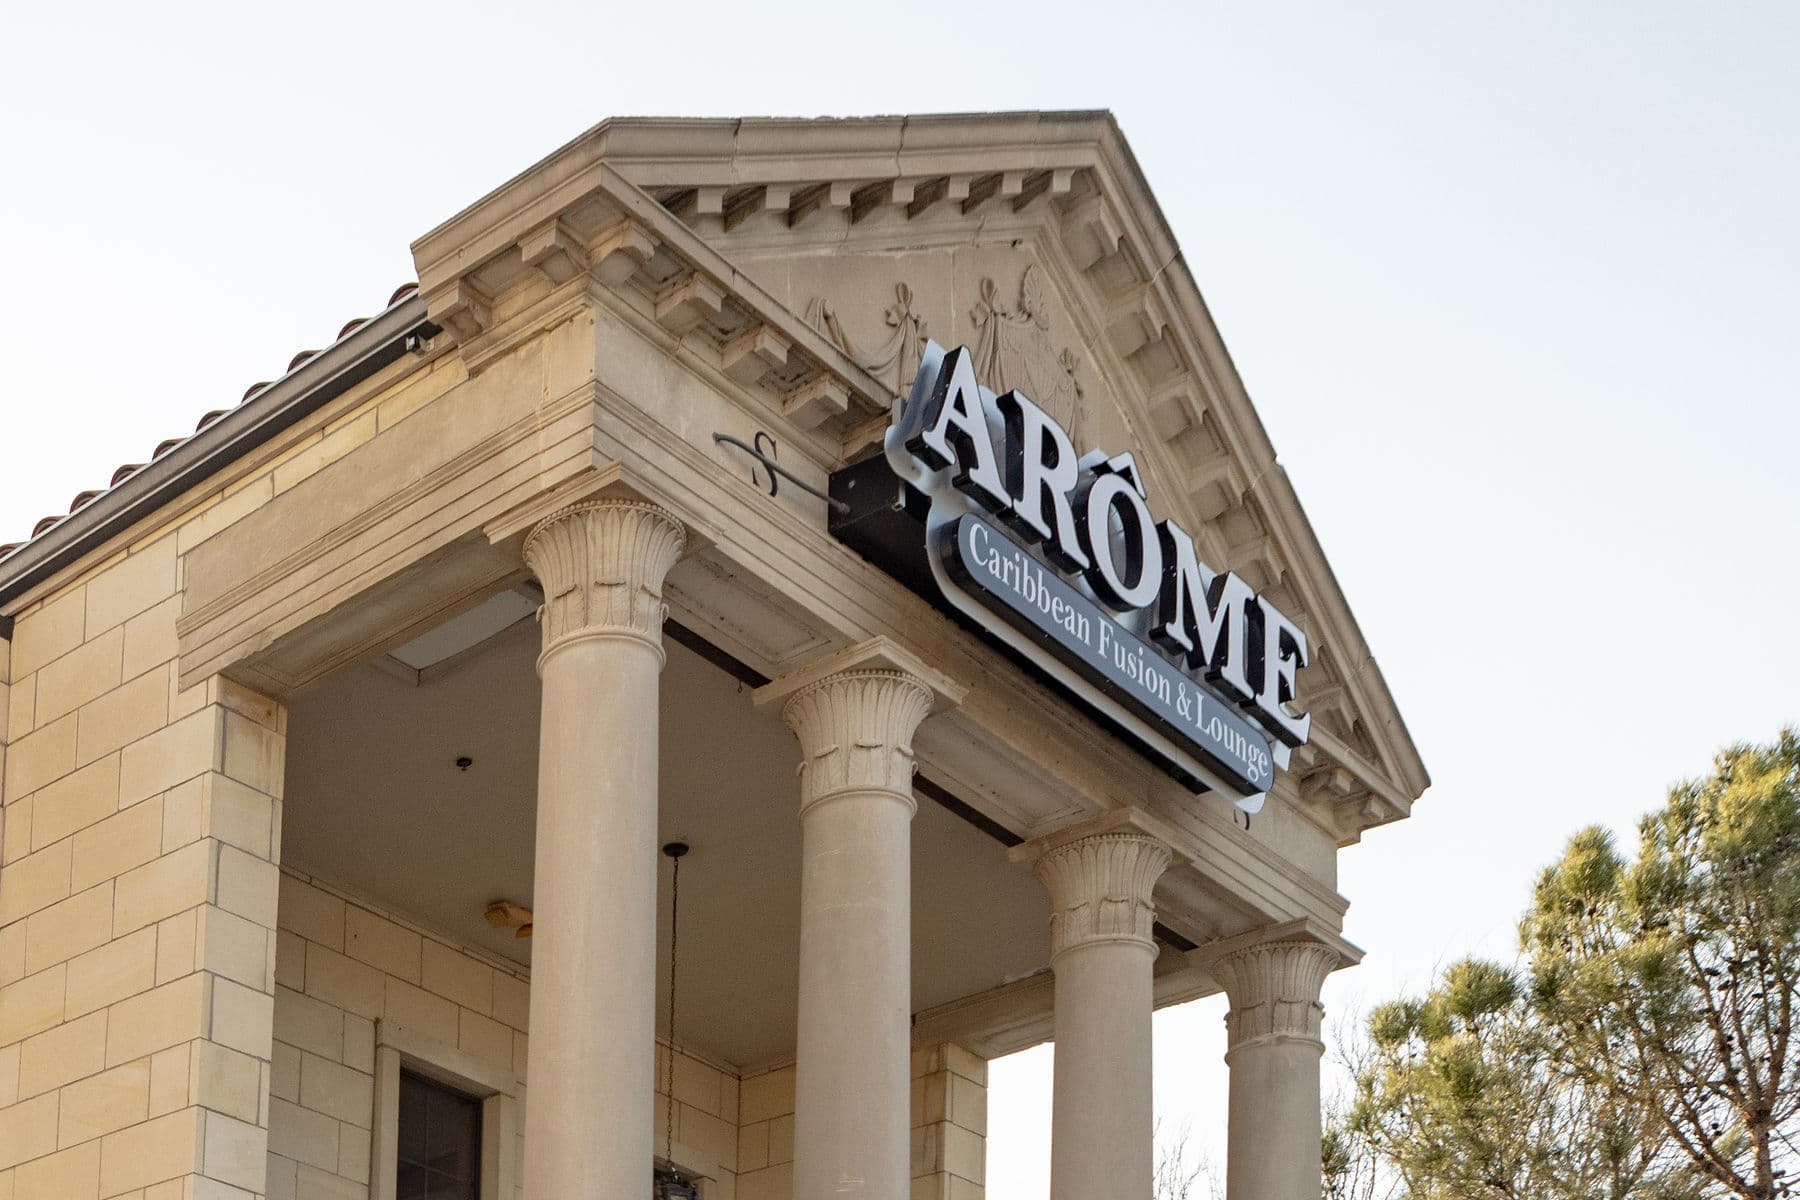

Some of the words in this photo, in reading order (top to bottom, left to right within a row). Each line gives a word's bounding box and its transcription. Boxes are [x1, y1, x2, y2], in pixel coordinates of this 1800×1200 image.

[920, 344, 1311, 741] ARÔME
[969, 522, 1091, 646] Caribbean
[1097, 616, 1172, 706] Fusion
[1176, 681, 1193, 722] &
[1195, 692, 1269, 783] Lounge
